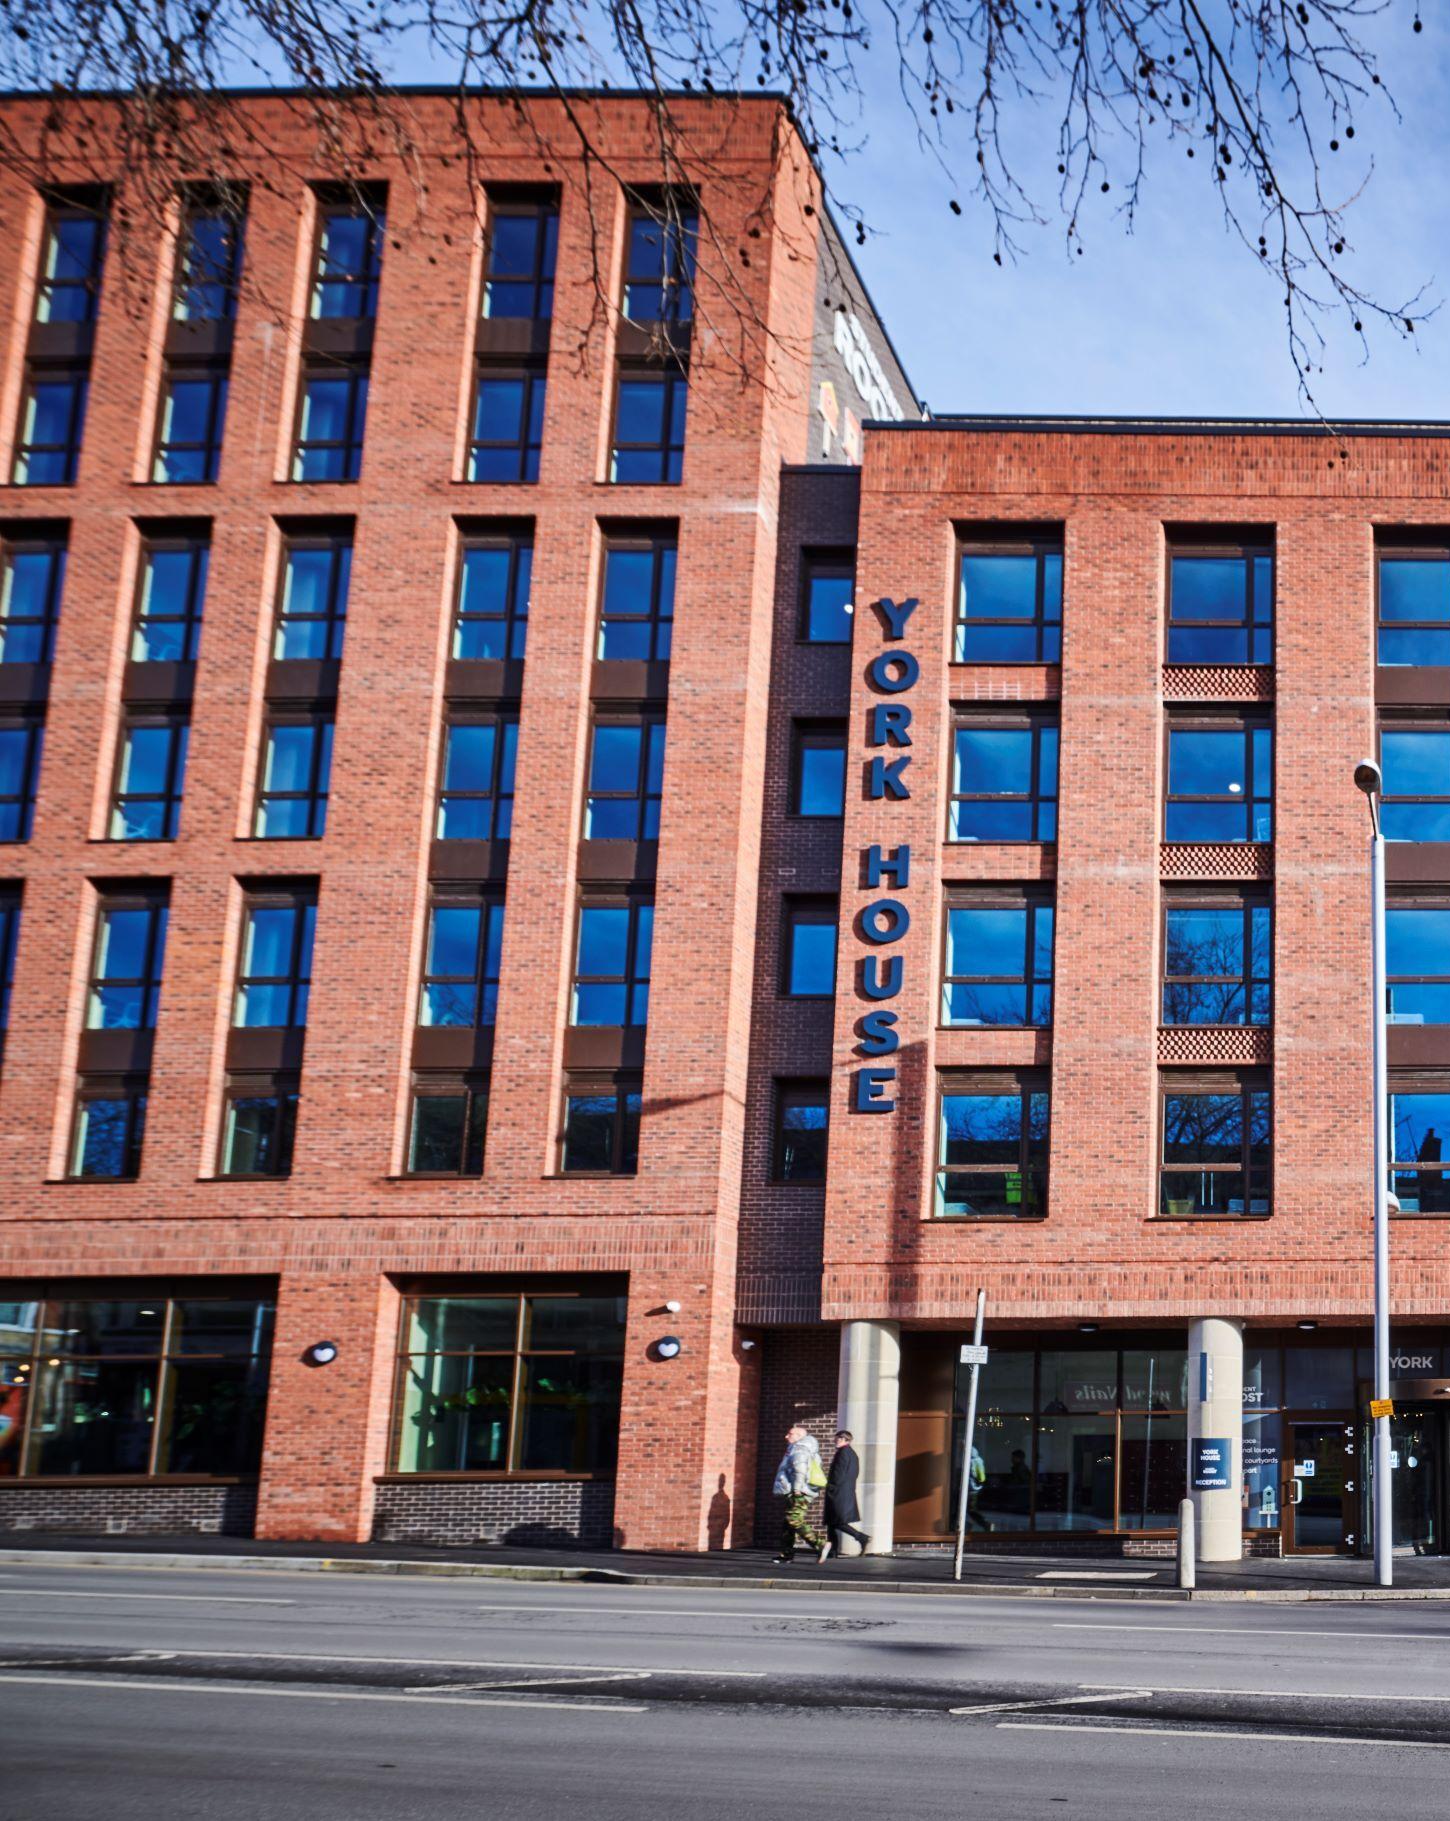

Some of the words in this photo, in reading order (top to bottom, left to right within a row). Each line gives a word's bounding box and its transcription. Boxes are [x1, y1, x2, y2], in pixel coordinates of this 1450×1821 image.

[870, 597, 920, 800] YORK
[857, 844, 911, 1112] HOUSE
[1390, 1356, 1433, 1369] YORK
[1254, 1447, 1276, 1455] lounge
[1245, 1458, 1278, 1466] courtyards
